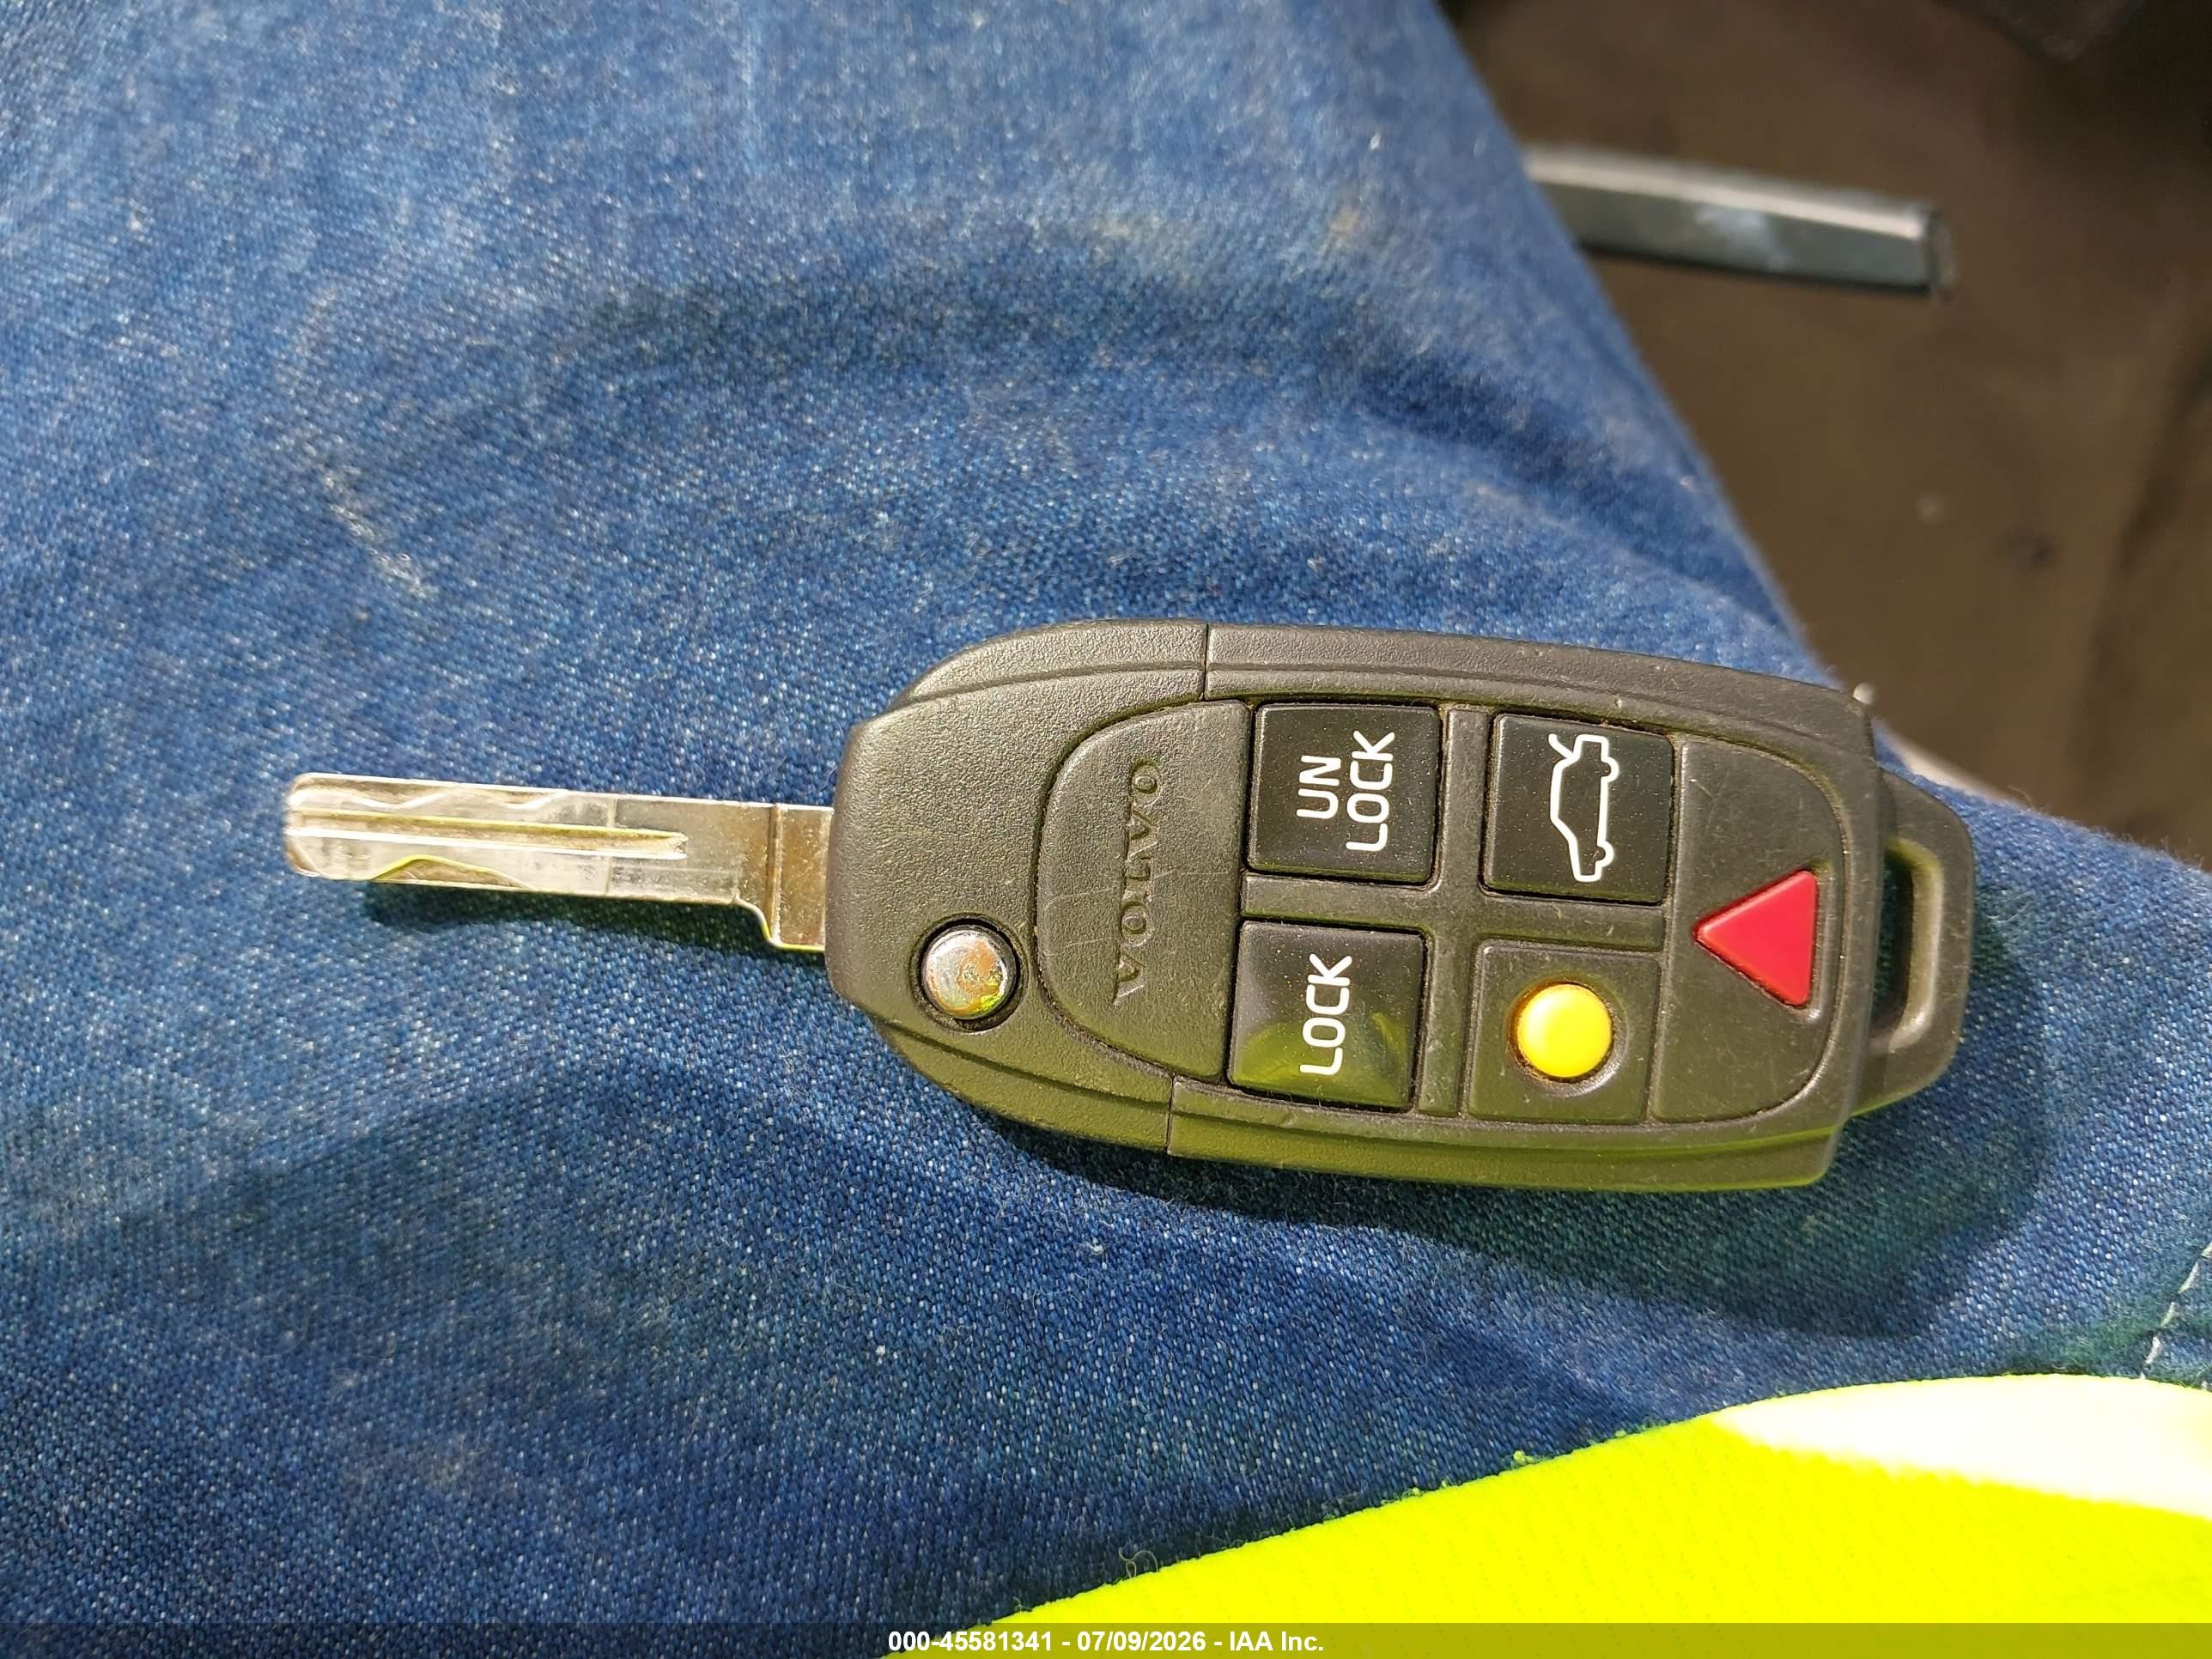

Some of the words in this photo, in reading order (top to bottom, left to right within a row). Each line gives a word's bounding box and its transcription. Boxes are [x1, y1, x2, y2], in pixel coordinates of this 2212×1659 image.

[1296, 755, 1341, 820] UN
[1345, 730, 1396, 852] LOCK
[1115, 756, 1160, 1006] VOLVO
[1299, 953, 1353, 1076] LOCK
